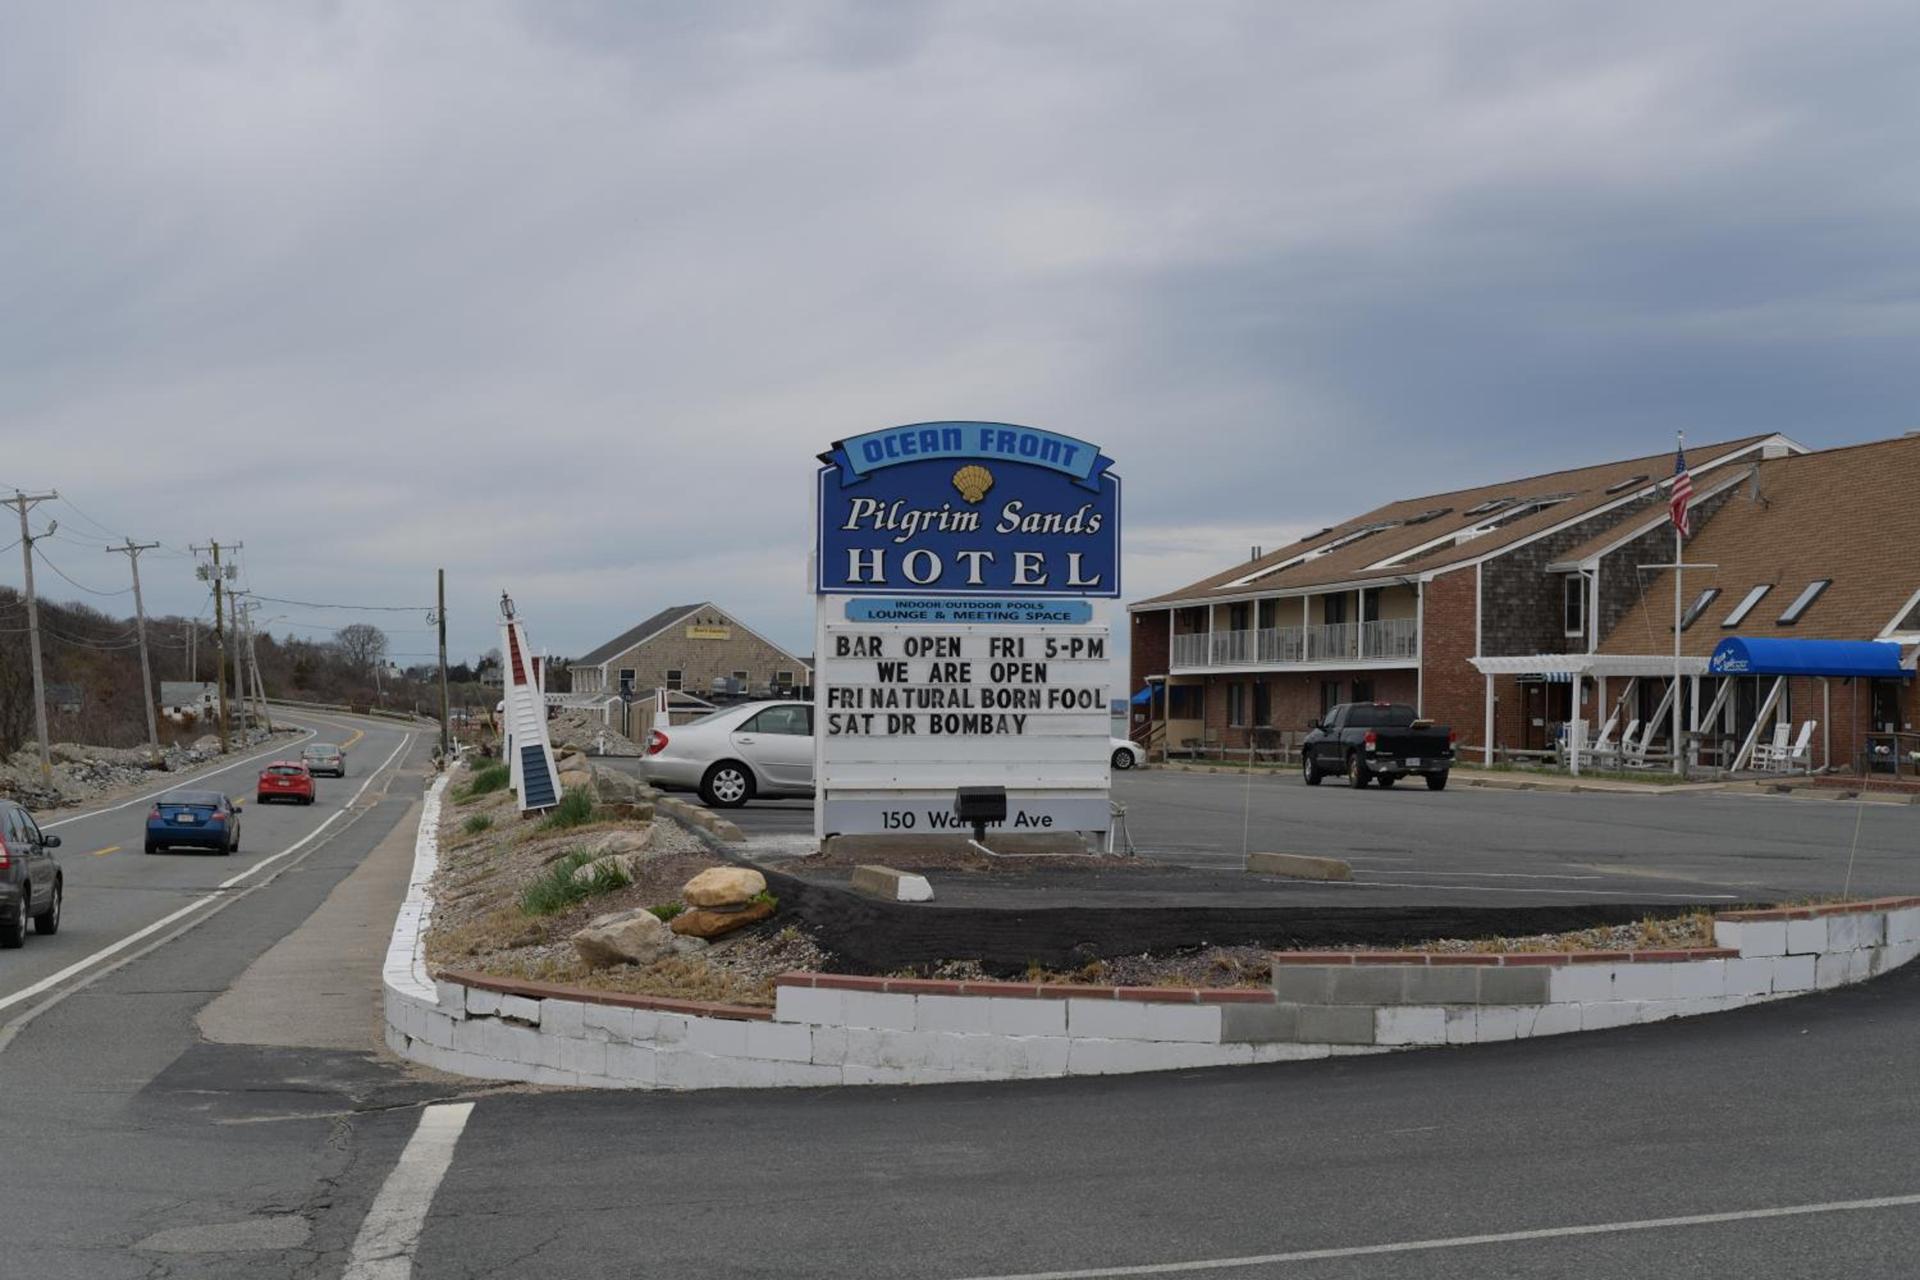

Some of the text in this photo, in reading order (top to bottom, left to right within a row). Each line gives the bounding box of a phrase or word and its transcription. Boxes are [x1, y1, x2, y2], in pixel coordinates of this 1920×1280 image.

[862, 428, 1079, 467] OCEAN FRONT
[842, 497, 1102, 543] Pilgrim Sands
[845, 548, 1101, 586] HOTEL
[868, 610, 1071, 620] LOUNGE & MEETING SPACE
[836, 636, 1104, 659] BAR OPEN FRI 5-PM
[877, 662, 1047, 683] WE ARE OPEN
[827, 687, 1107, 709] FRI NATURAL BORN FOOL
[828, 714, 1027, 735] SAT DR BOMBAY
[882, 811, 1053, 829] 150 Warn Ave
